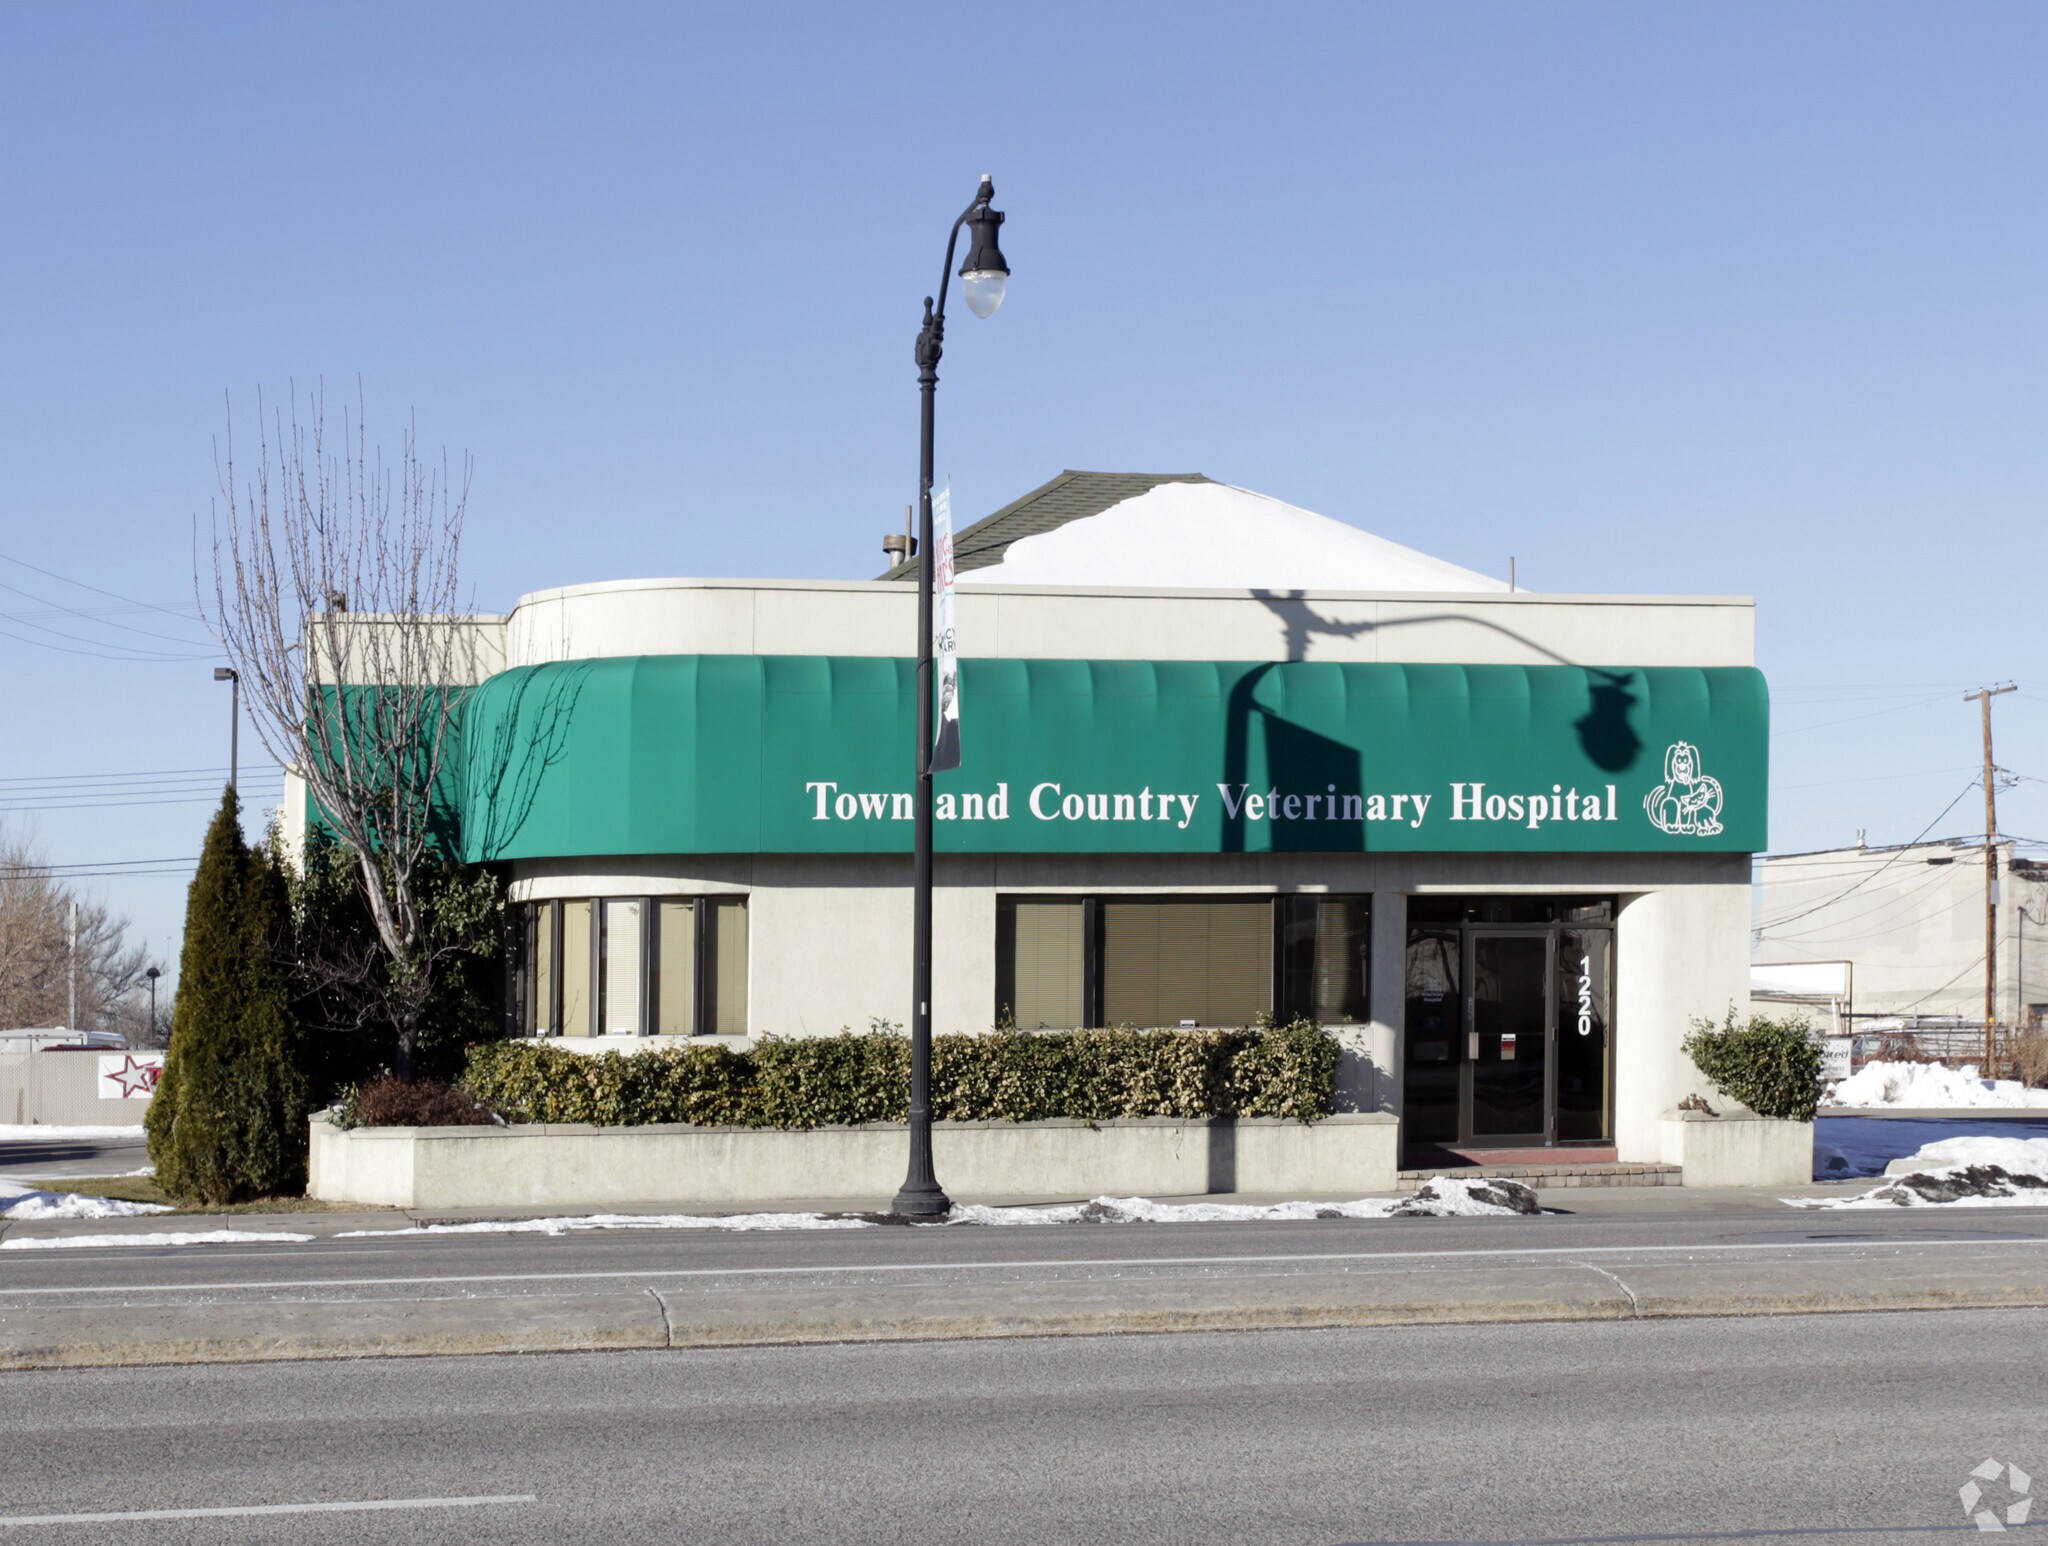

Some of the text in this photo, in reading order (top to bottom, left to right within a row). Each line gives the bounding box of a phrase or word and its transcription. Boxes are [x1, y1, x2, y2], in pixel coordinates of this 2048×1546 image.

[806, 782, 1618, 829] Town and Country Veterinary Hospital
[1578, 956, 1591, 1036] 1220
